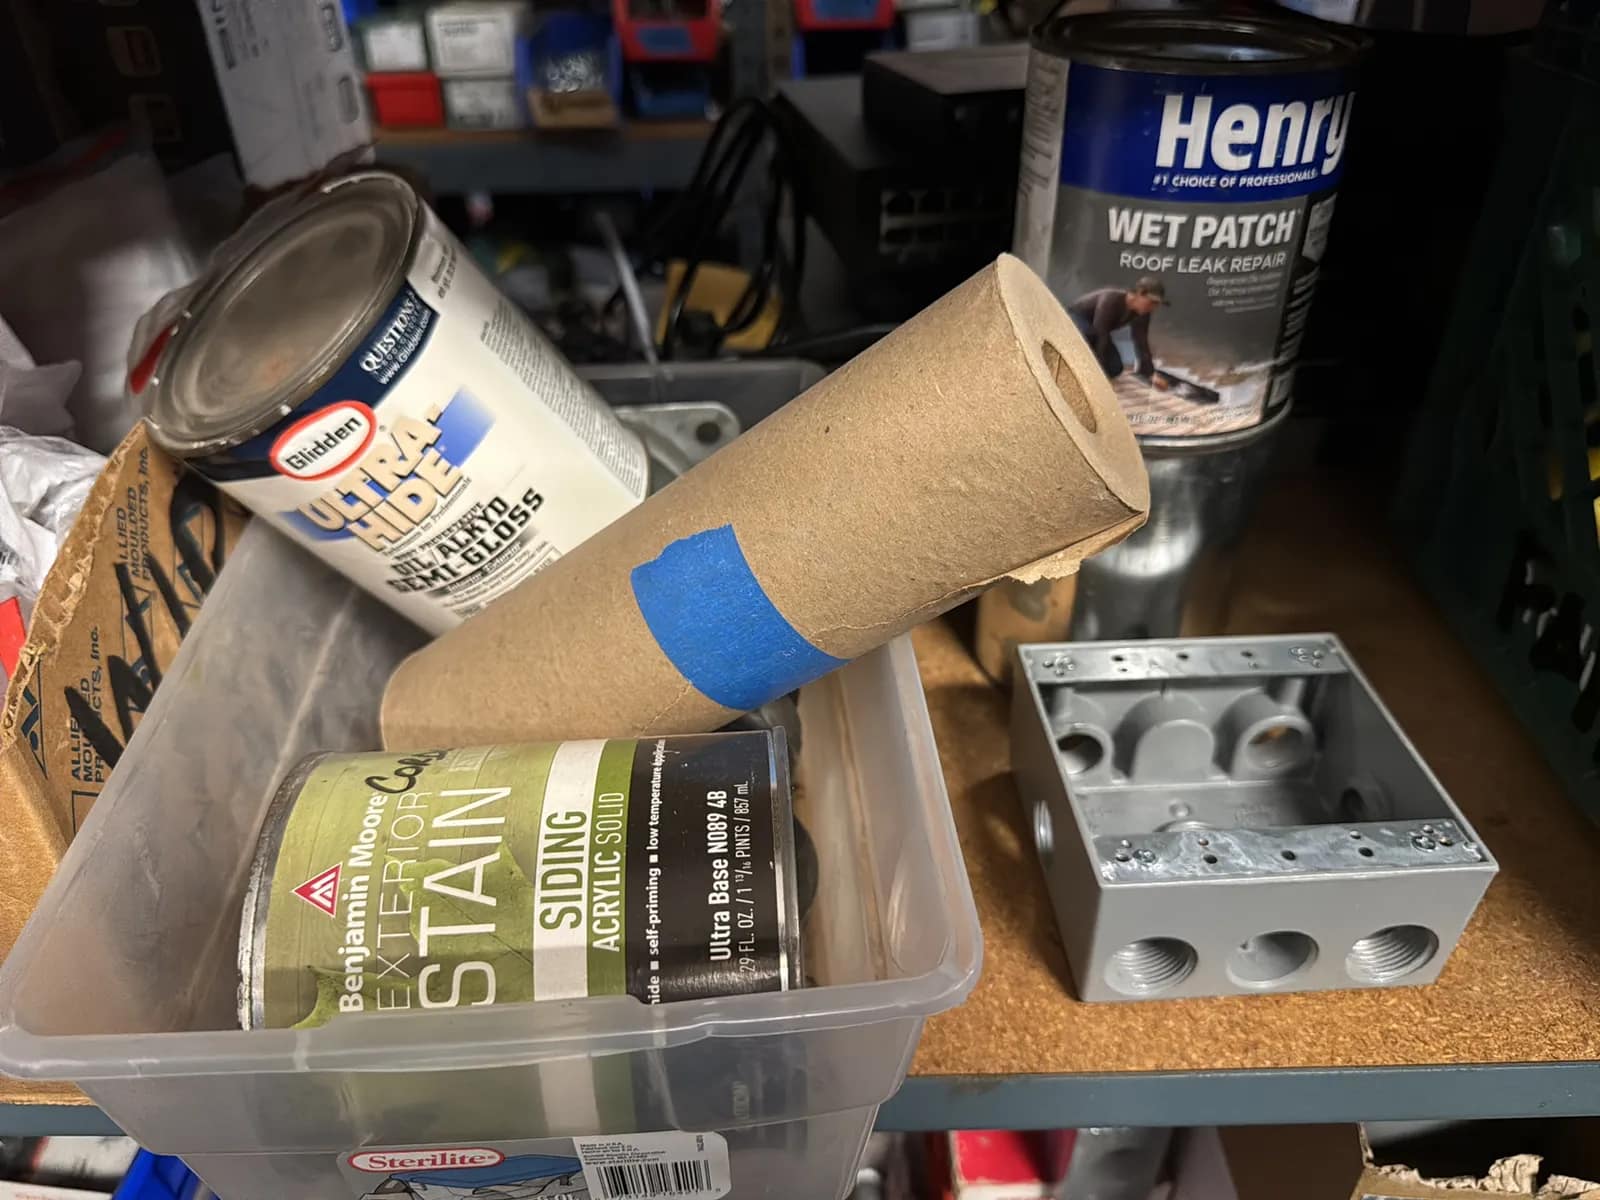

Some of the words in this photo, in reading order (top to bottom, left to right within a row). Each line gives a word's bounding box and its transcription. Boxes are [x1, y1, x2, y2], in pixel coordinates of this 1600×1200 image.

[1155, 91, 1356, 175] Henry
[1153, 174, 1168, 186] #1
[1172, 175, 1217, 188] CHOICE
[1219, 177, 1237, 188] OF
[1239, 169, 1317, 187] PROFESSIONALS
[1108, 206, 1187, 249] WET
[1190, 209, 1298, 249] PATCH
[1119, 252, 1174, 272] ROOF
[1177, 256, 1226, 273] LEAK
[1229, 251, 1287, 273] REPAIR
[285, 416, 363, 472] Glidden
[350, 447, 465, 553] HIDE
[116, 507, 132, 560] LLIED
[127, 486, 142, 577] MOULDED
[387, 487, 544, 594] SEMI-GLOSS
[391, 496, 508, 576] OIL/ALKYD
[90, 627, 99, 660] Inc.
[648, 767, 663, 826] temperature
[707, 789, 728, 808] 4B
[733, 780, 749, 795] mL
[733, 797, 750, 815] 857
[348, 793, 388, 867] Moore
[595, 792, 625, 845] SOLID
[646, 827, 660, 850] low
[734, 825, 751, 859] PINTS
[539, 810, 587, 930] SIDING
[708, 857, 730, 905] Base
[376, 791, 433, 1011] EXTERIOR
[418, 786, 512, 1009] STAIN
[591, 850, 622, 952] ACRYLIC
[645, 866, 662, 955] self-priming
[737, 908, 754, 929] OZ.
[338, 875, 371, 1013] Benjamin
[709, 910, 732, 961] Ultra
[738, 932, 755, 953] FL.
[738, 956, 756, 974] 29
[368, 1152, 487, 1169] Sterilite
